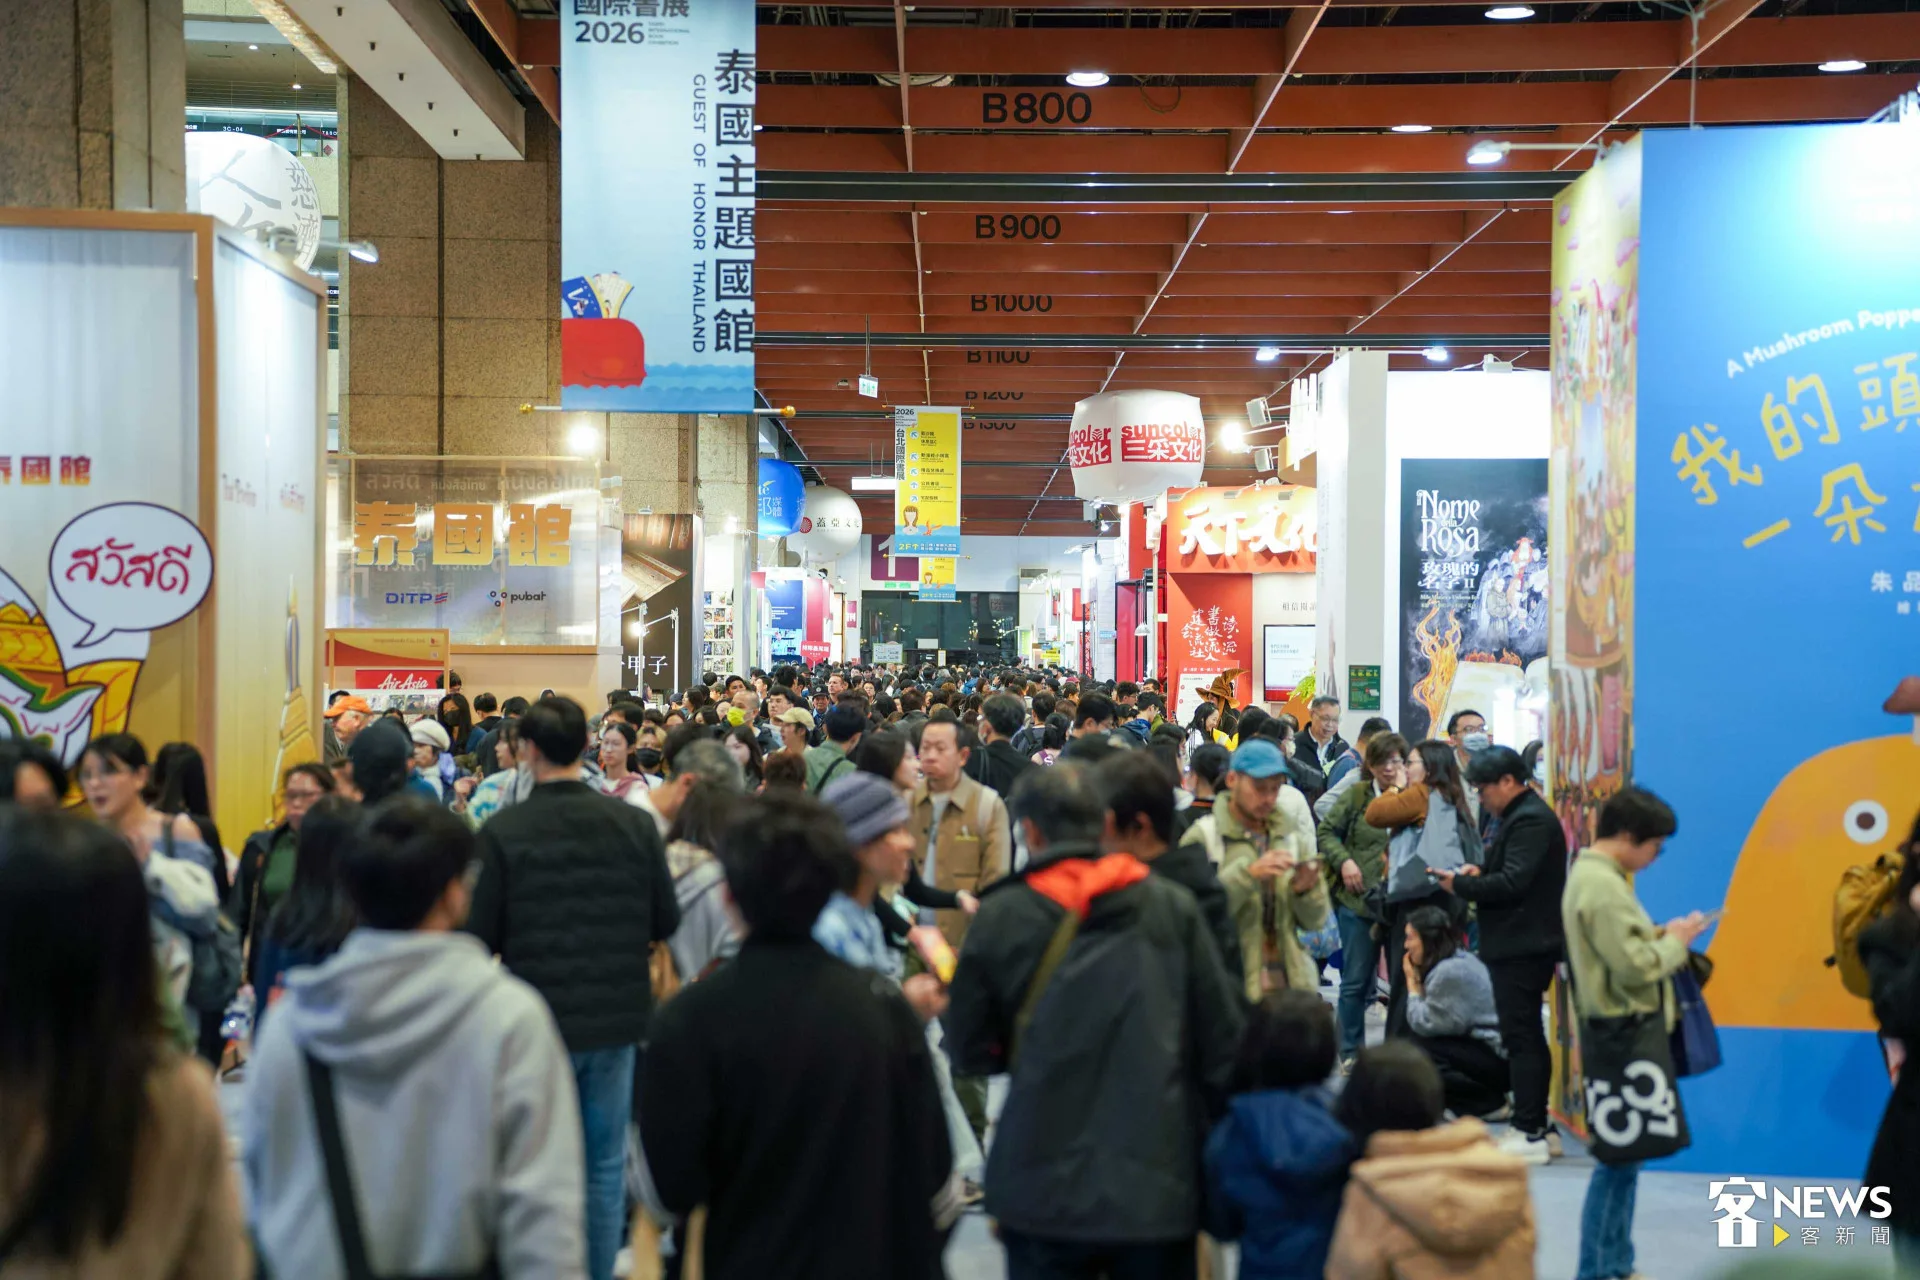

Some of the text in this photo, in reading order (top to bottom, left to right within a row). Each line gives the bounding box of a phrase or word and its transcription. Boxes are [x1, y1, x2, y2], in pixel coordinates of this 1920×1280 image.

[575, 21, 645, 44] 2026
[982, 92, 1092, 124] B800
[693, 74, 706, 353] GUEST OF HONOR THAILAND
[713, 48, 756, 353] 泰國主題國館
[975, 214, 1062, 240] B900
[970, 294, 1053, 313] B1000
[1727, 358, 1744, 379] A
[1743, 318, 1854, 368] Mushroom
[895, 408, 915, 416] 2026
[1670, 352, 1920, 506] 我的頭
[896, 428, 906, 480] 台北國際書展
[1421, 490, 1480, 527] Nome
[1743, 462, 1920, 549] 一朵
[354, 501, 572, 567] 泰國館
[1179, 503, 1316, 556] 天下文化
[1421, 518, 1480, 557] Rosa
[65, 537, 193, 595] สวัสดี
[510, 592, 547, 603] pubat
[621, 655, 668, 676] 甲子
